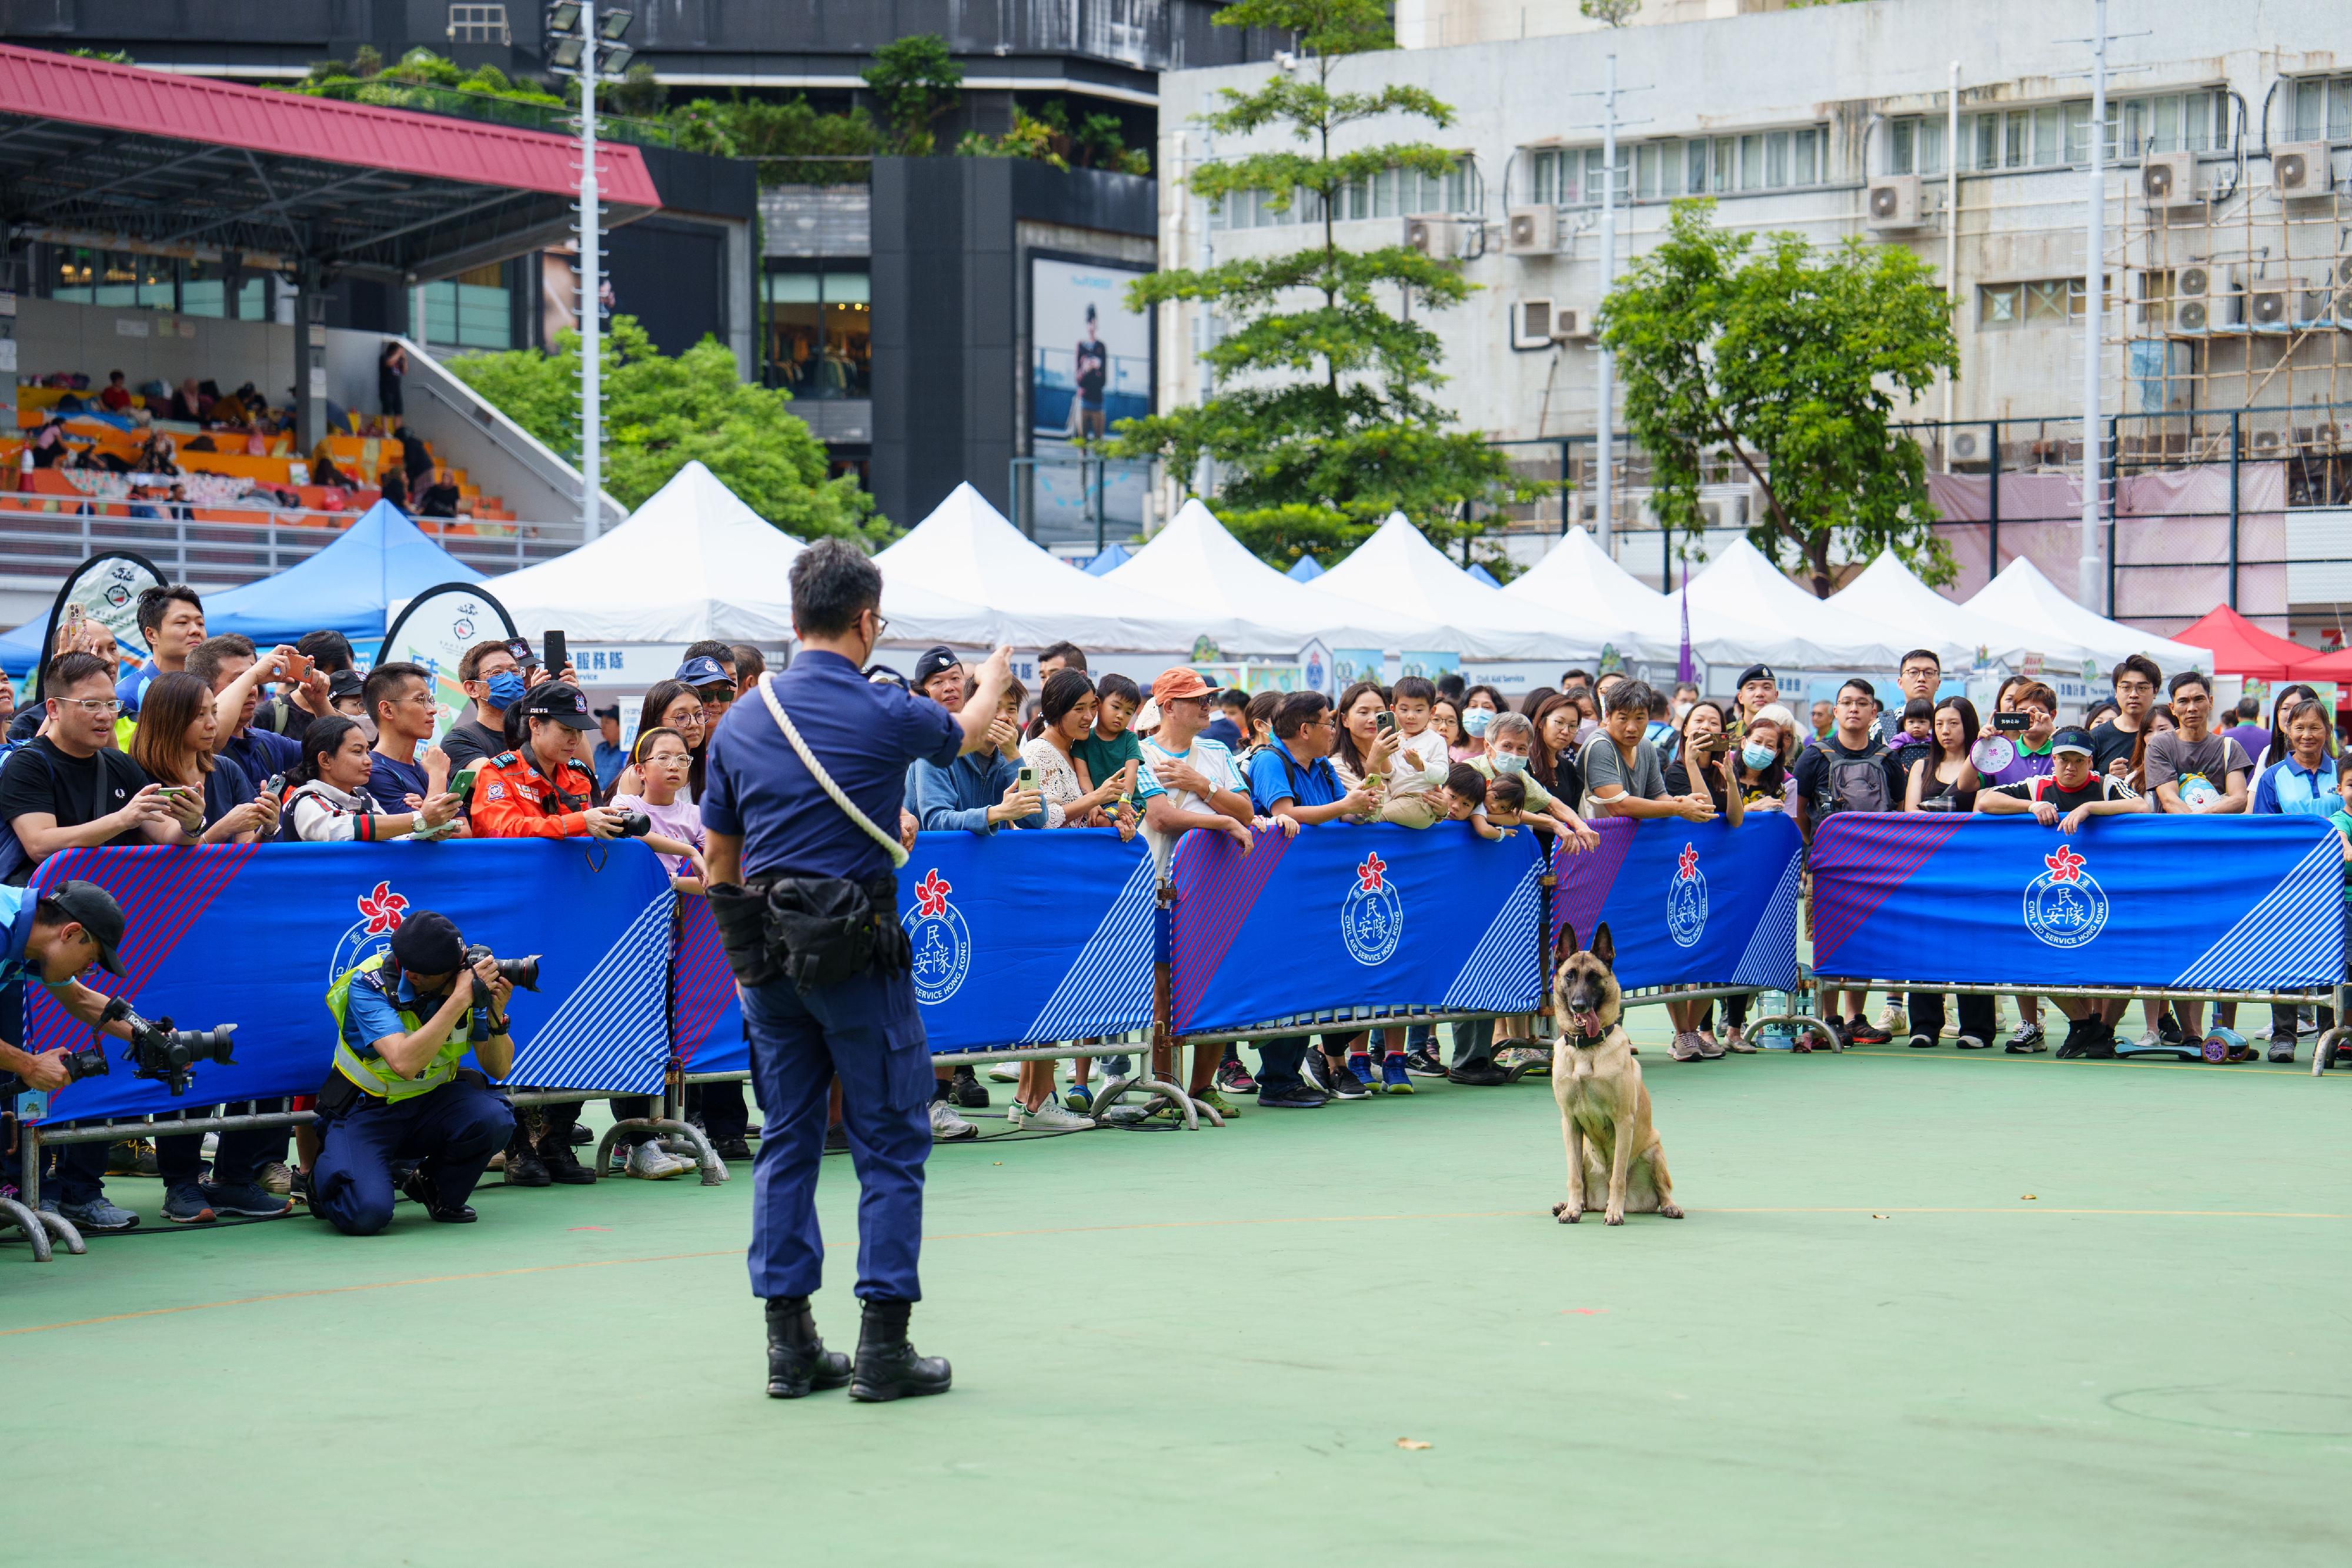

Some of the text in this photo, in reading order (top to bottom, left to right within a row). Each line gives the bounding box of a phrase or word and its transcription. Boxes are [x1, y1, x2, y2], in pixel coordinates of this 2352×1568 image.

[1503, 674, 1525, 683] Service
[1684, 885, 1693, 904] 民
[2057, 887, 2078, 907] 民
[1366, 898, 1381, 918] 民
[1676, 902, 1698, 923] 安隊
[2043, 904, 2087, 926] 安隊
[926, 924, 944, 949] 民
[1357, 915, 1388, 940] 安隊
[2032, 922, 2044, 934] AID
[2044, 932, 2077, 944] SERVICE
[2079, 926, 2097, 941] HONG
[1349, 939, 1358, 952] AID
[1358, 950, 1382, 961] SERVICE
[1382, 938, 1395, 957] HONG
[913, 947, 952, 975] 安隊
[915, 941, 967, 999] SERVICE HONG KONG
[128, 1014, 151, 1034] RONIN
